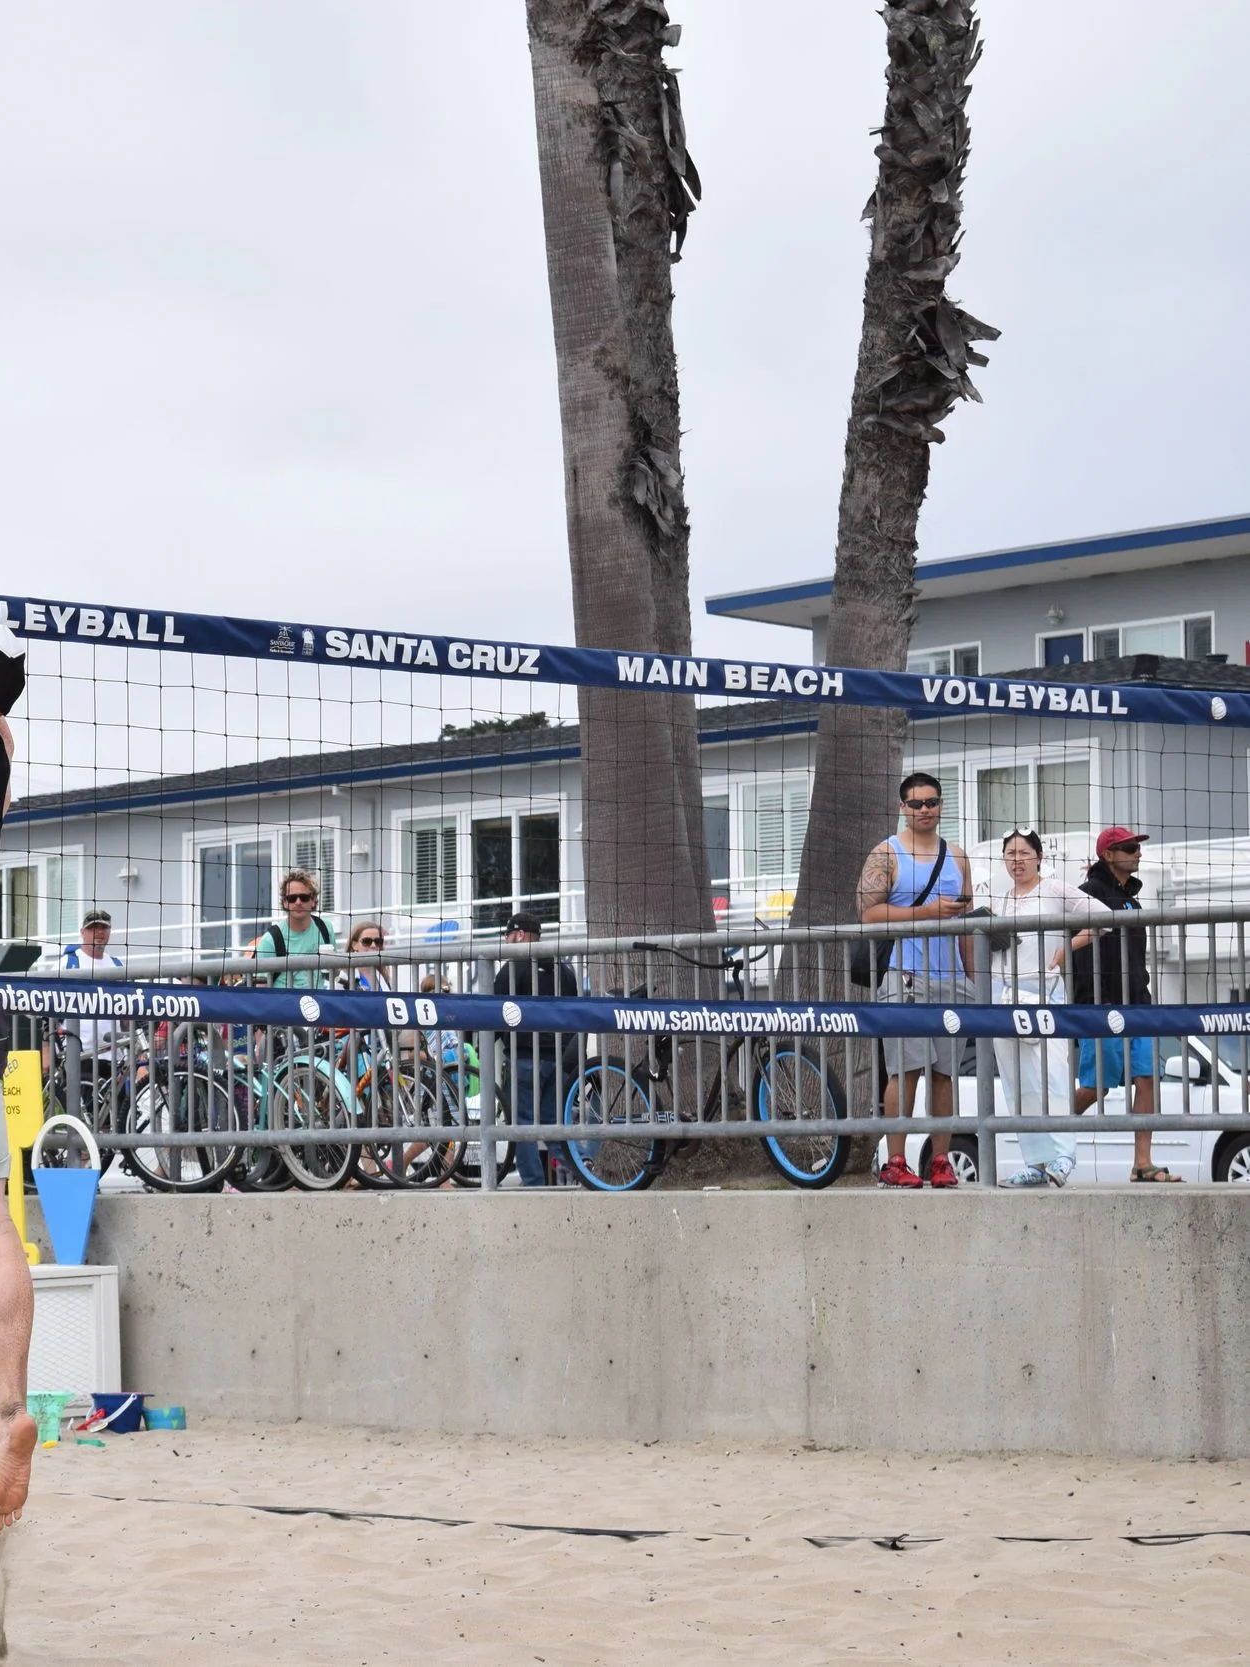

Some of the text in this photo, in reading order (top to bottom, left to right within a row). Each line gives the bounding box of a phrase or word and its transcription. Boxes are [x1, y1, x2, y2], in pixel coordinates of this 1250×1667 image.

[325, 629, 439, 667] SANTA
[448, 642, 541, 675] CRUZ
[617, 656, 844, 697] MAIN BEACH
[921, 678, 1129, 715] VOLLEYBALL
[614, 1006, 859, 1033] www.santacruzwharf.com
[2, 1086, 21, 1096] EACH
[5, 1105, 21, 1115] OYS
